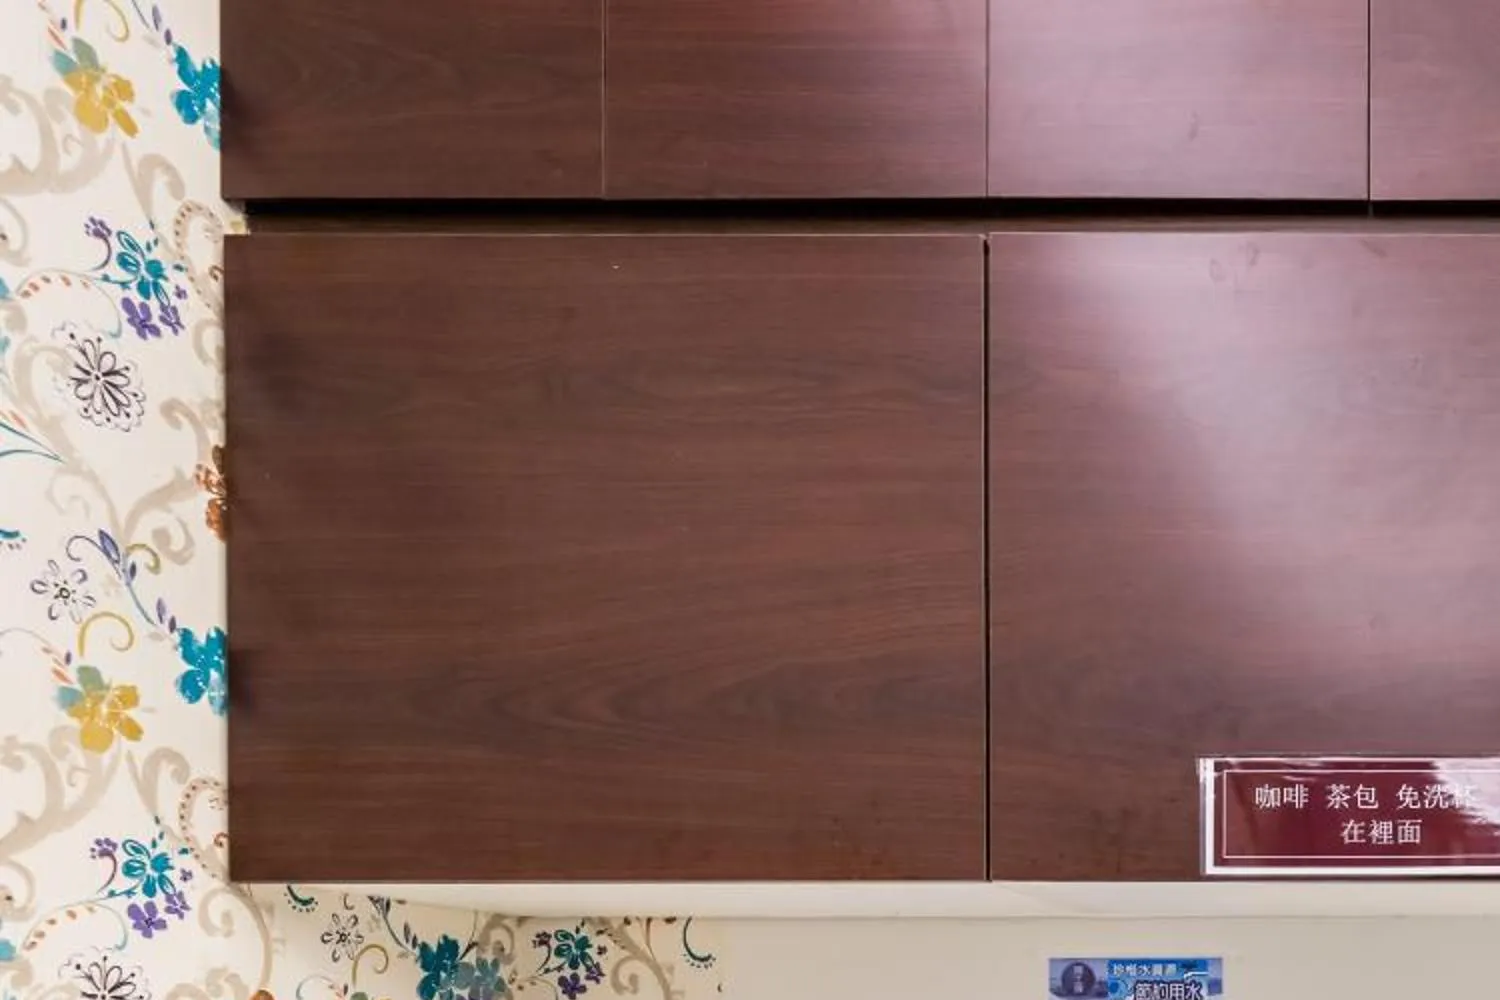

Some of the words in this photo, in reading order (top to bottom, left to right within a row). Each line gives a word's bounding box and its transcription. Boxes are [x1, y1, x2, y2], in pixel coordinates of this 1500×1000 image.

[1255, 784, 1309, 809] 咖啡
[1326, 784, 1380, 809] 茶包
[1341, 818, 1424, 845] 在裡面
